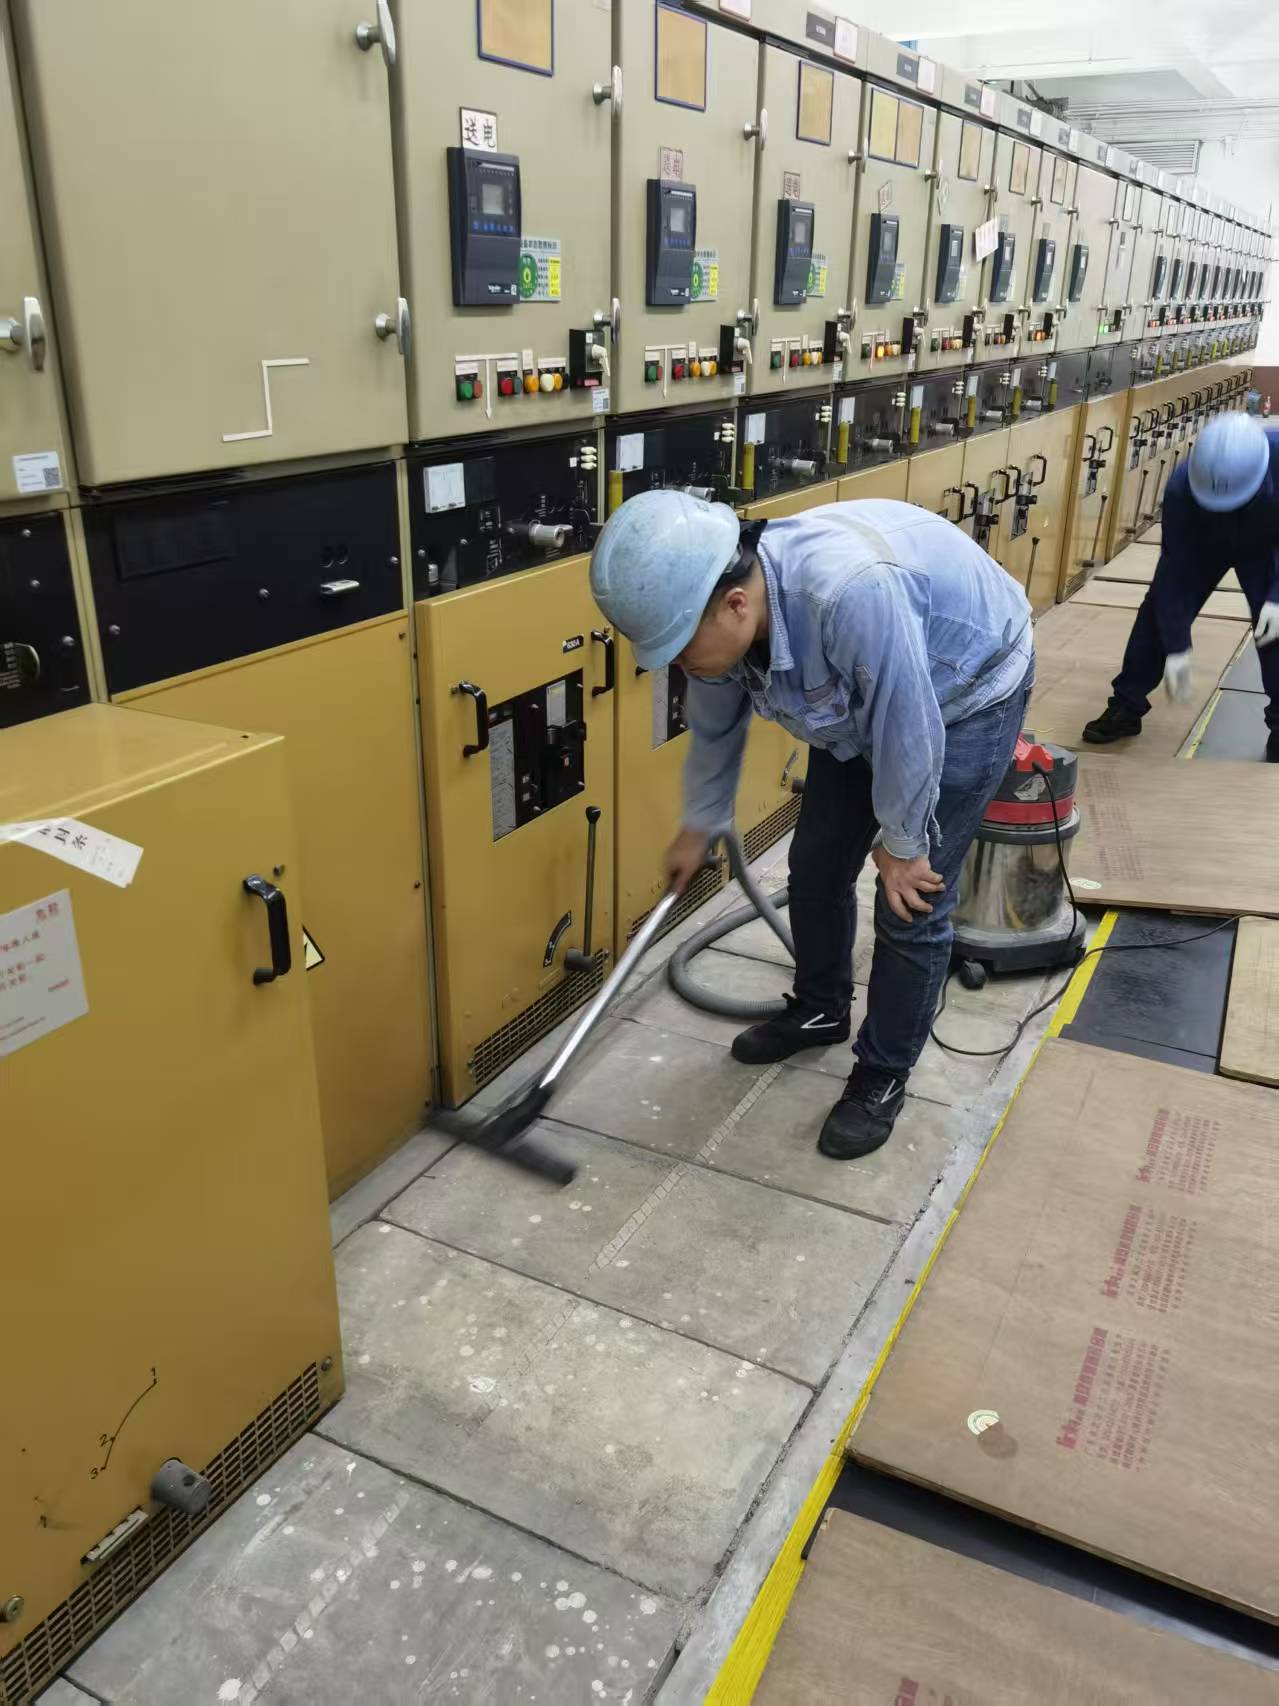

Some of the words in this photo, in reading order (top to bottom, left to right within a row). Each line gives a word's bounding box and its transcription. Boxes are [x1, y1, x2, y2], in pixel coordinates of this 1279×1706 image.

[464, 117, 496, 148] 送电
[99, 1433, 111, 1447] 2
[90, 1467, 99, 1480] 3
